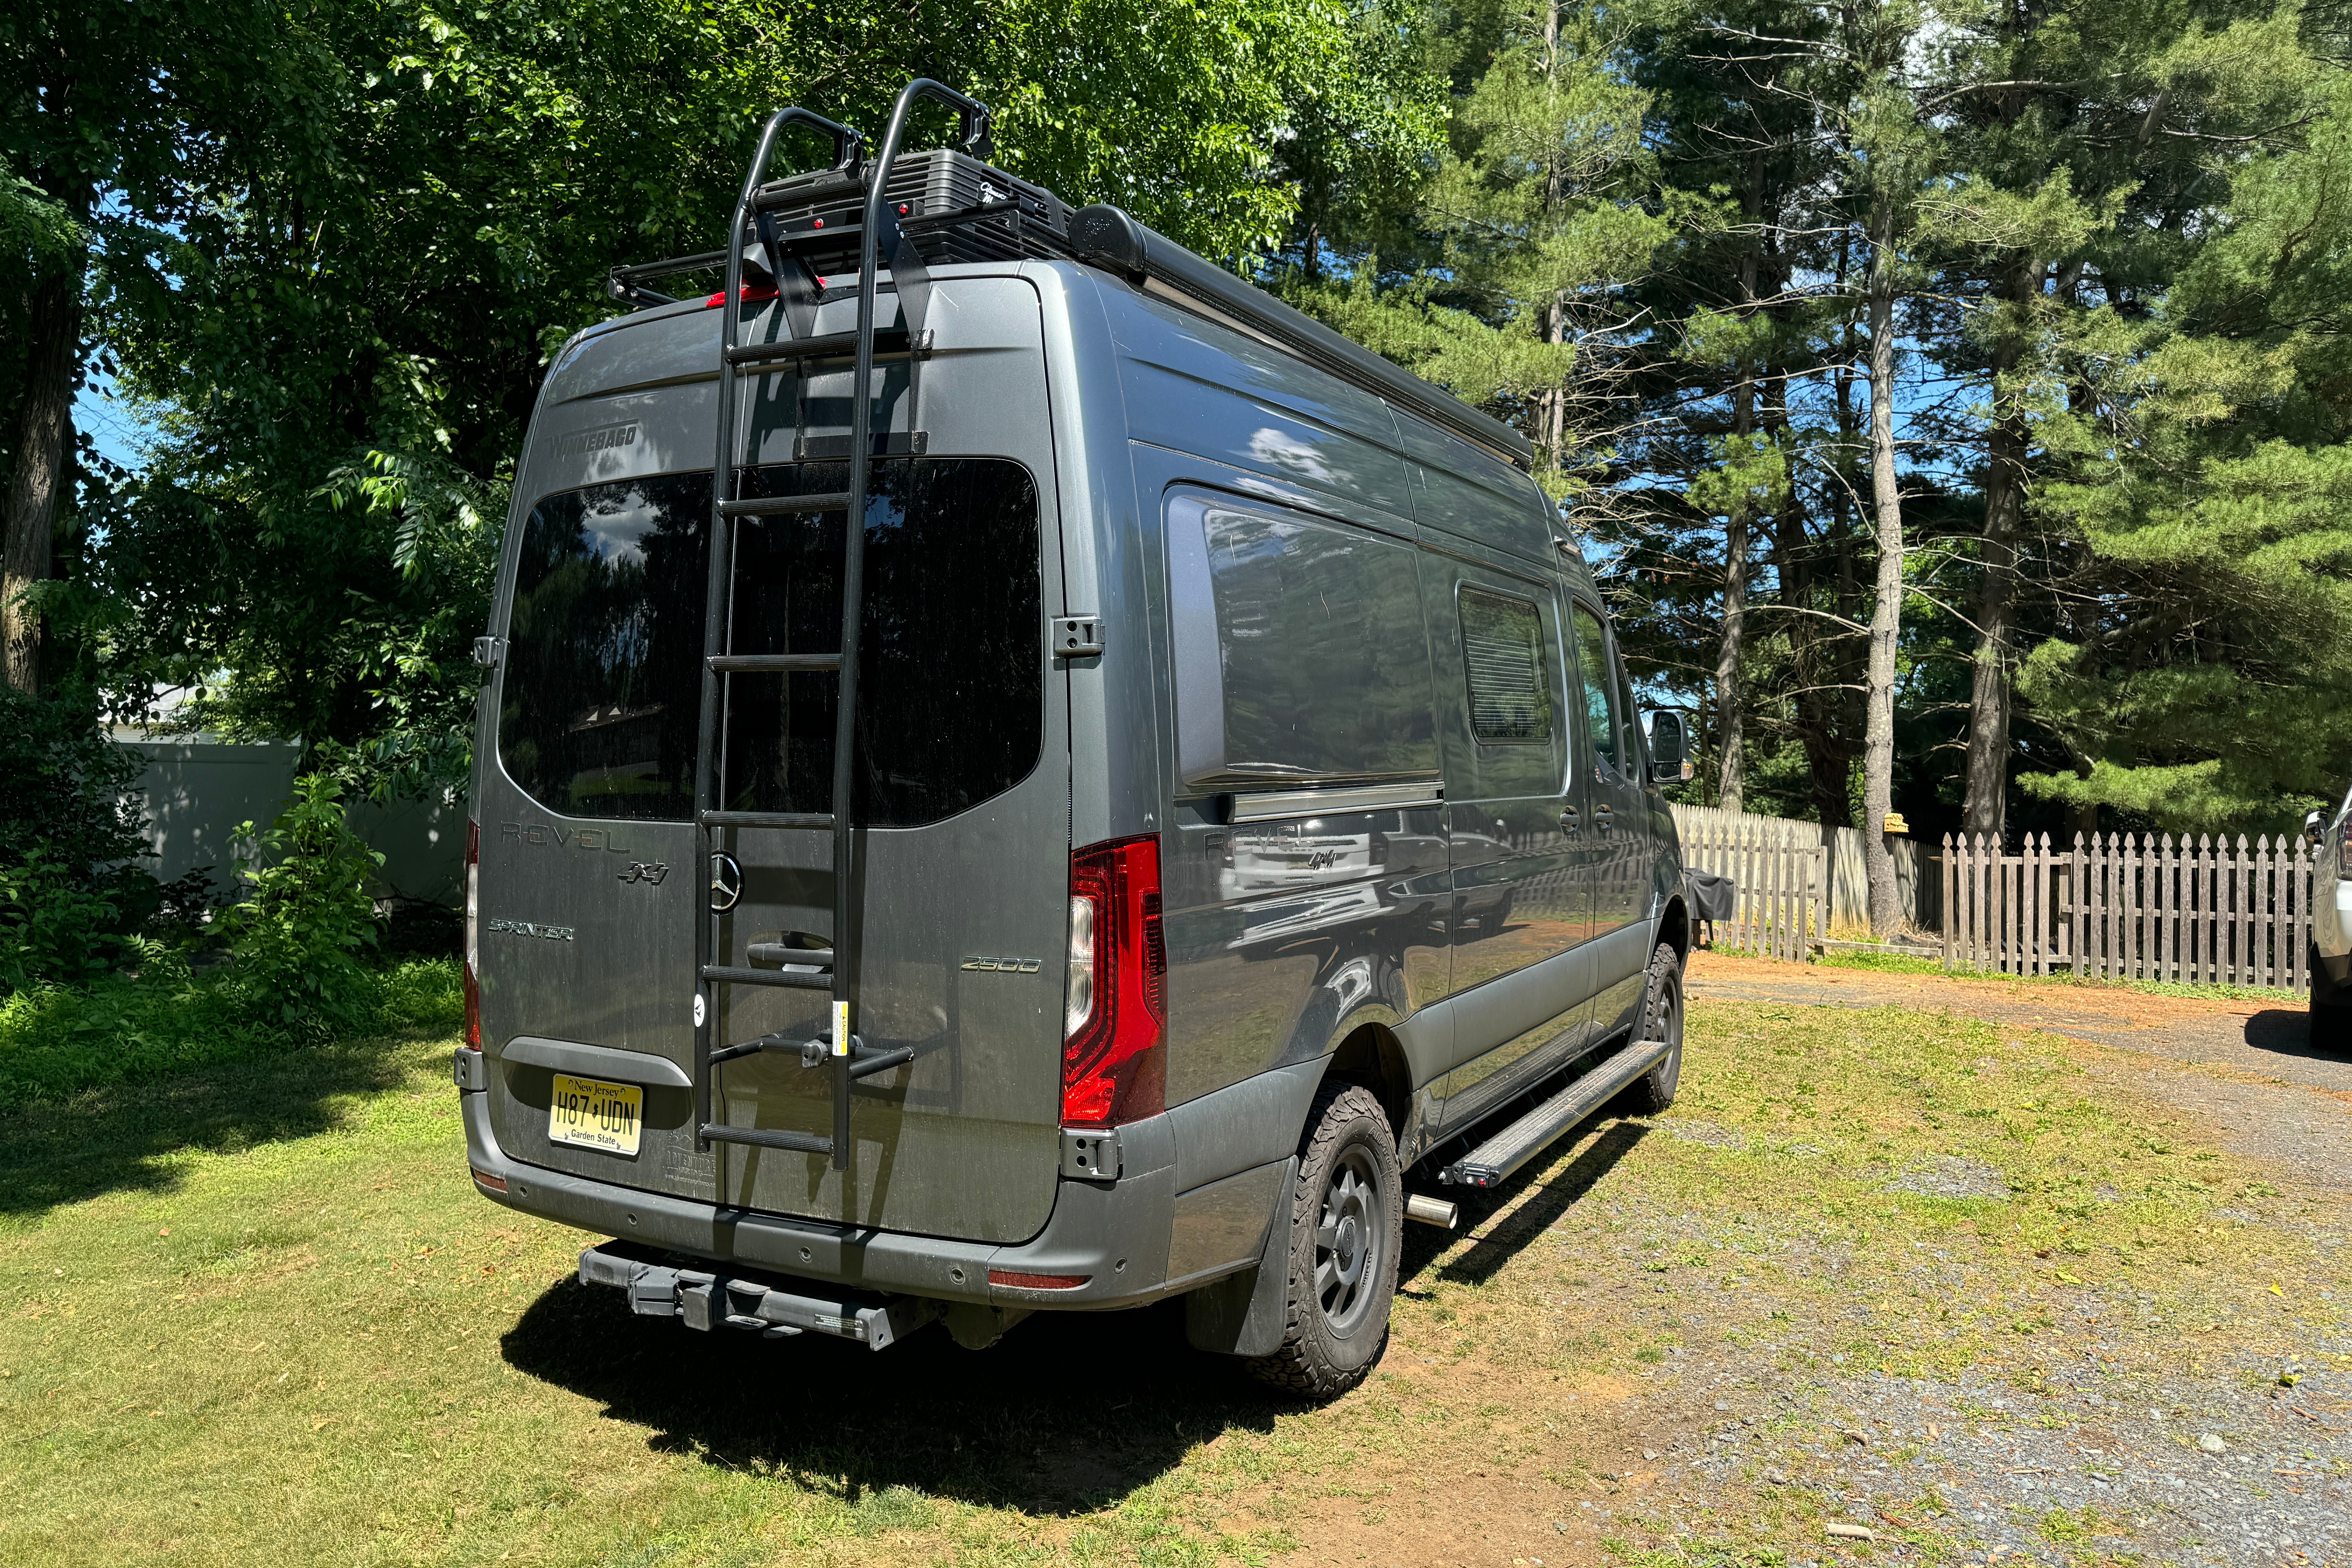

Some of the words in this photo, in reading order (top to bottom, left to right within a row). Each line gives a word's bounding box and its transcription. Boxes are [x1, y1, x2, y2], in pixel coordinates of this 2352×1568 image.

[502, 822, 632, 854] REVEL
[1204, 824, 1315, 861] REVEL
[488, 919, 575, 941] SPRINTER
[960, 956, 1042, 973] 2500
[574, 1080, 593, 1092] New
[593, 1084, 619, 1099] Jersey
[557, 1091, 590, 1127] H87
[600, 1099, 635, 1136] UDN
[571, 1129, 595, 1141] Garden
[597, 1134, 616, 1145] State
